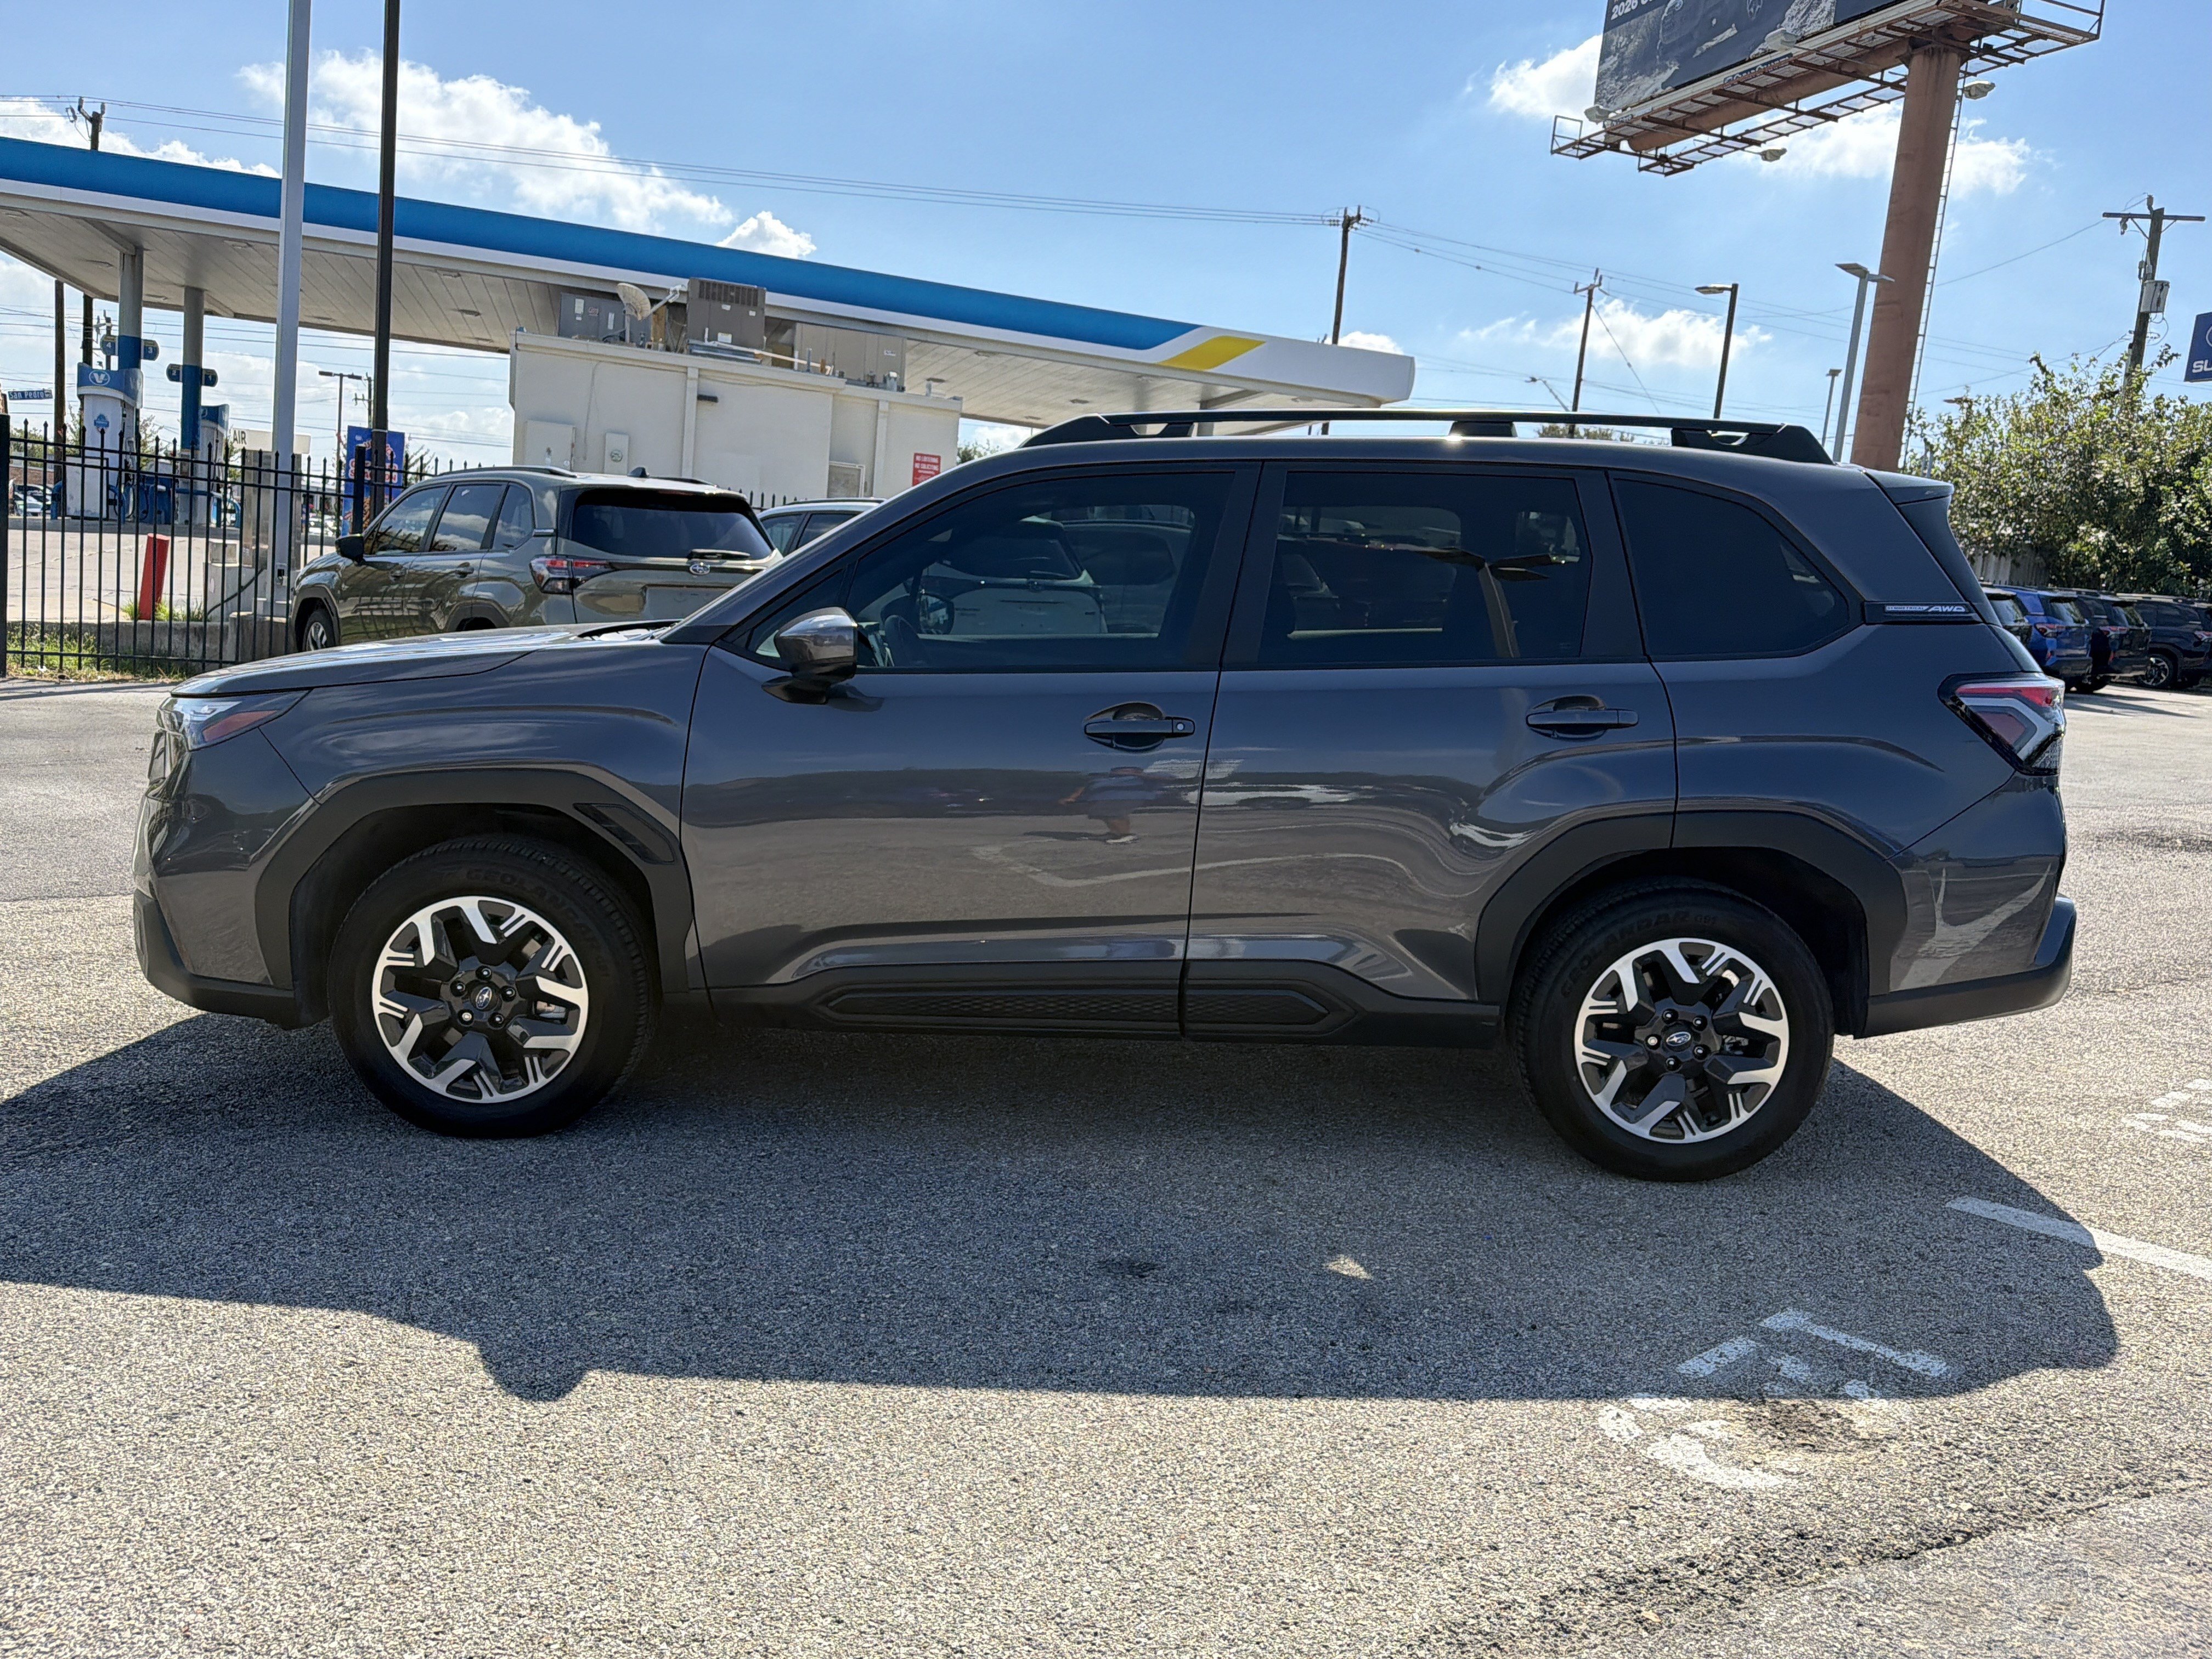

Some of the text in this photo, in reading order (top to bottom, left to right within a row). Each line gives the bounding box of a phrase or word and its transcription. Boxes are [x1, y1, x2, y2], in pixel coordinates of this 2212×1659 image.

[1611, 0, 1639, 20] 2026
[10, 391, 44, 399] San Pedro
[233, 430, 247, 445] AIR
